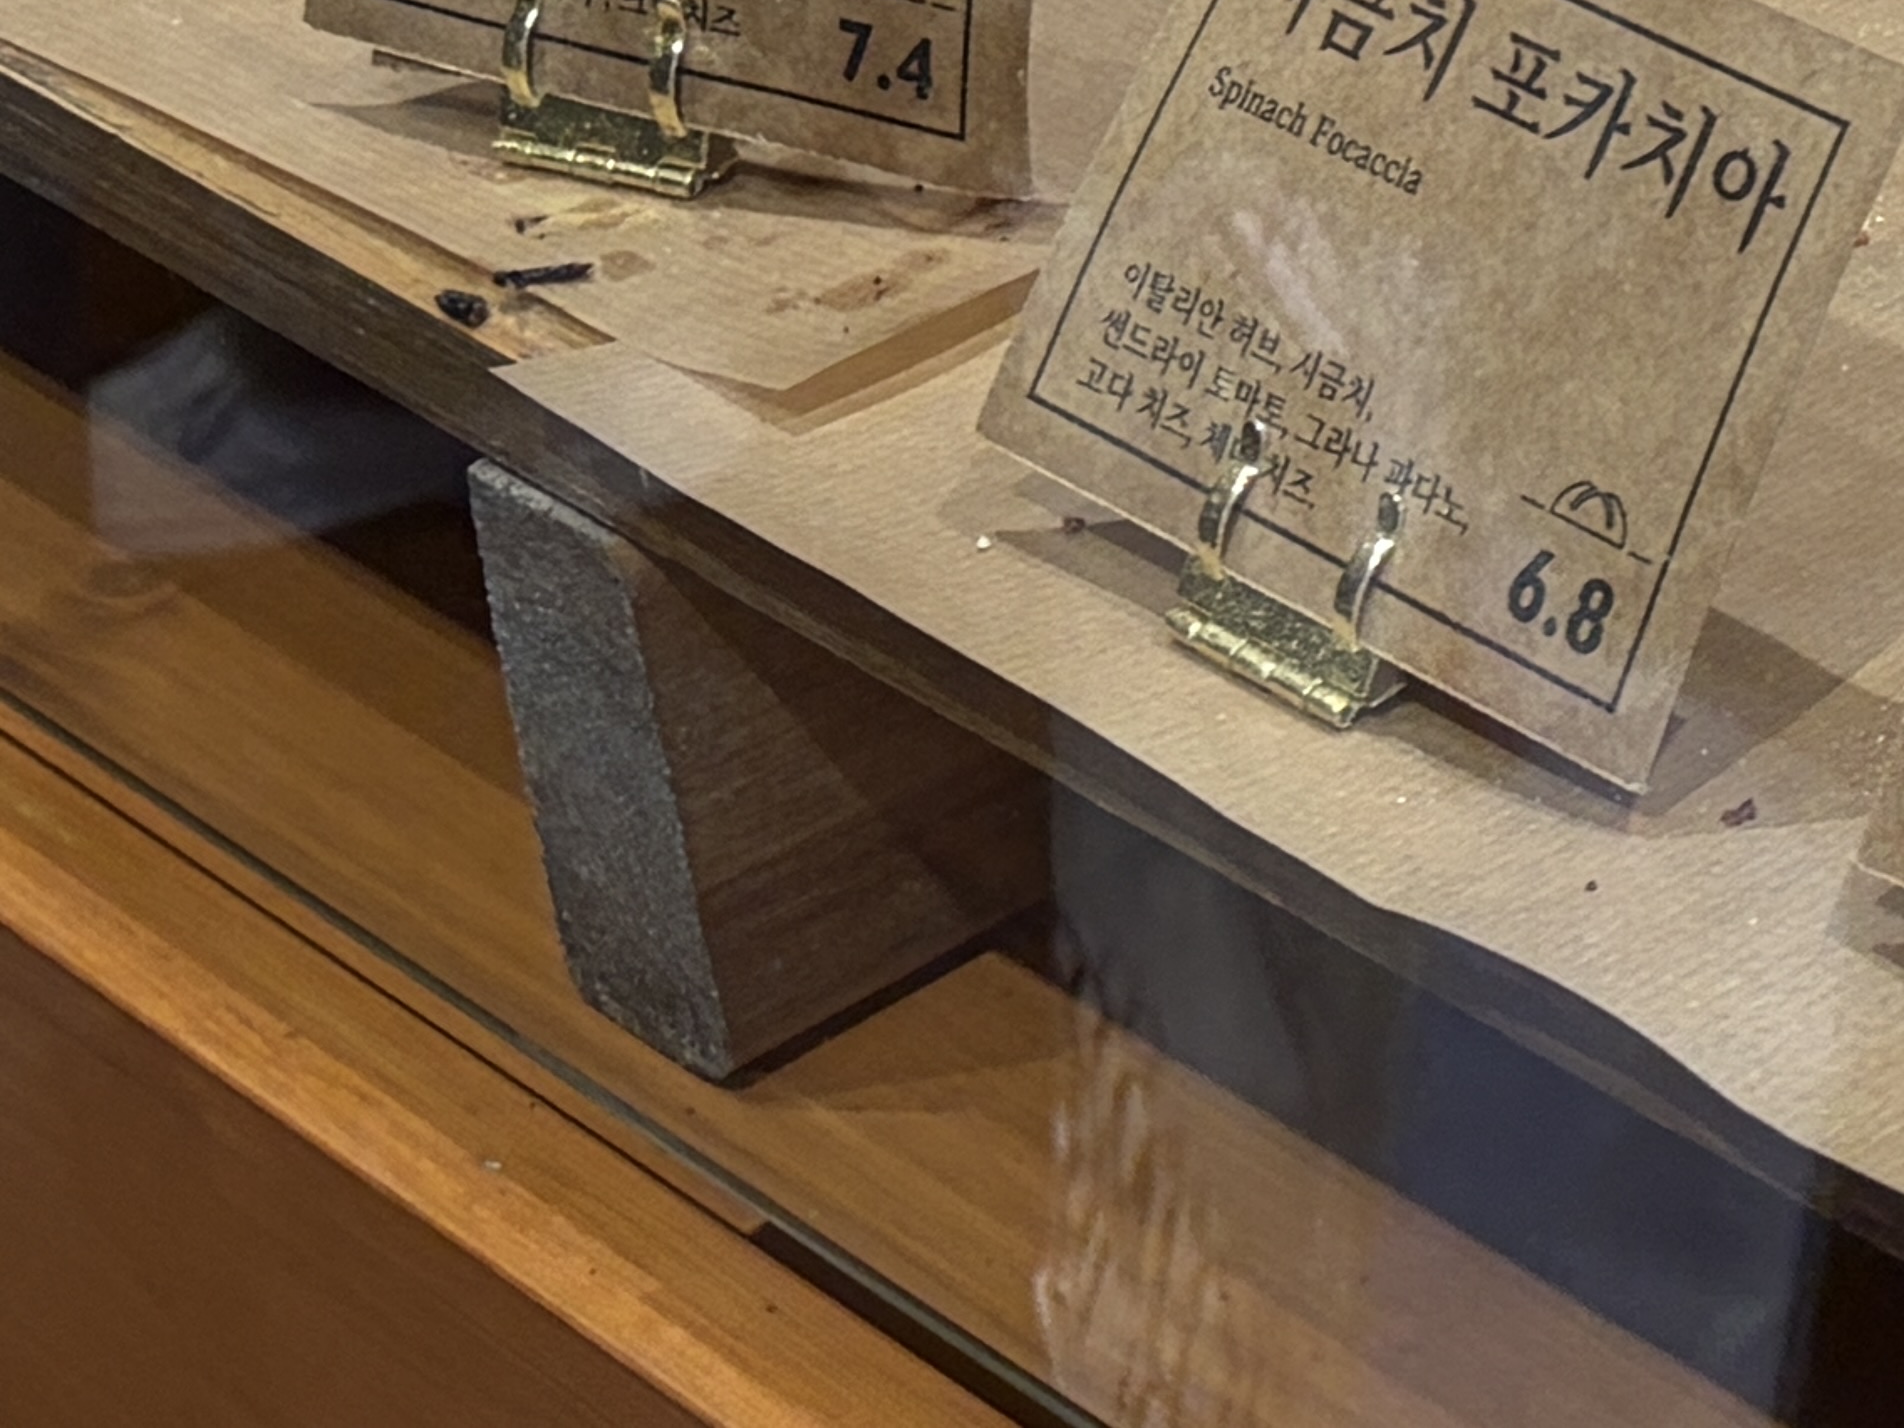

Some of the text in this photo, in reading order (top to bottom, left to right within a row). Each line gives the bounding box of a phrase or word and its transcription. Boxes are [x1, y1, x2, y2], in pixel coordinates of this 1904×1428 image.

[836, 18, 935, 100] 7.4
[1208, 65, 1425, 196] Spinach Focaccia
[1472, 30, 1790, 254] 포카치아
[1124, 262, 1376, 423] 이탈리안 허브, 시금치,
[1076, 357, 1134, 411] 고다
[1137, 382, 1193, 449] 치즈,
[1203, 366, 1289, 439] 토마토,
[1294, 414, 1379, 484] 그라나
[1507, 550, 1616, 658] 6.8
